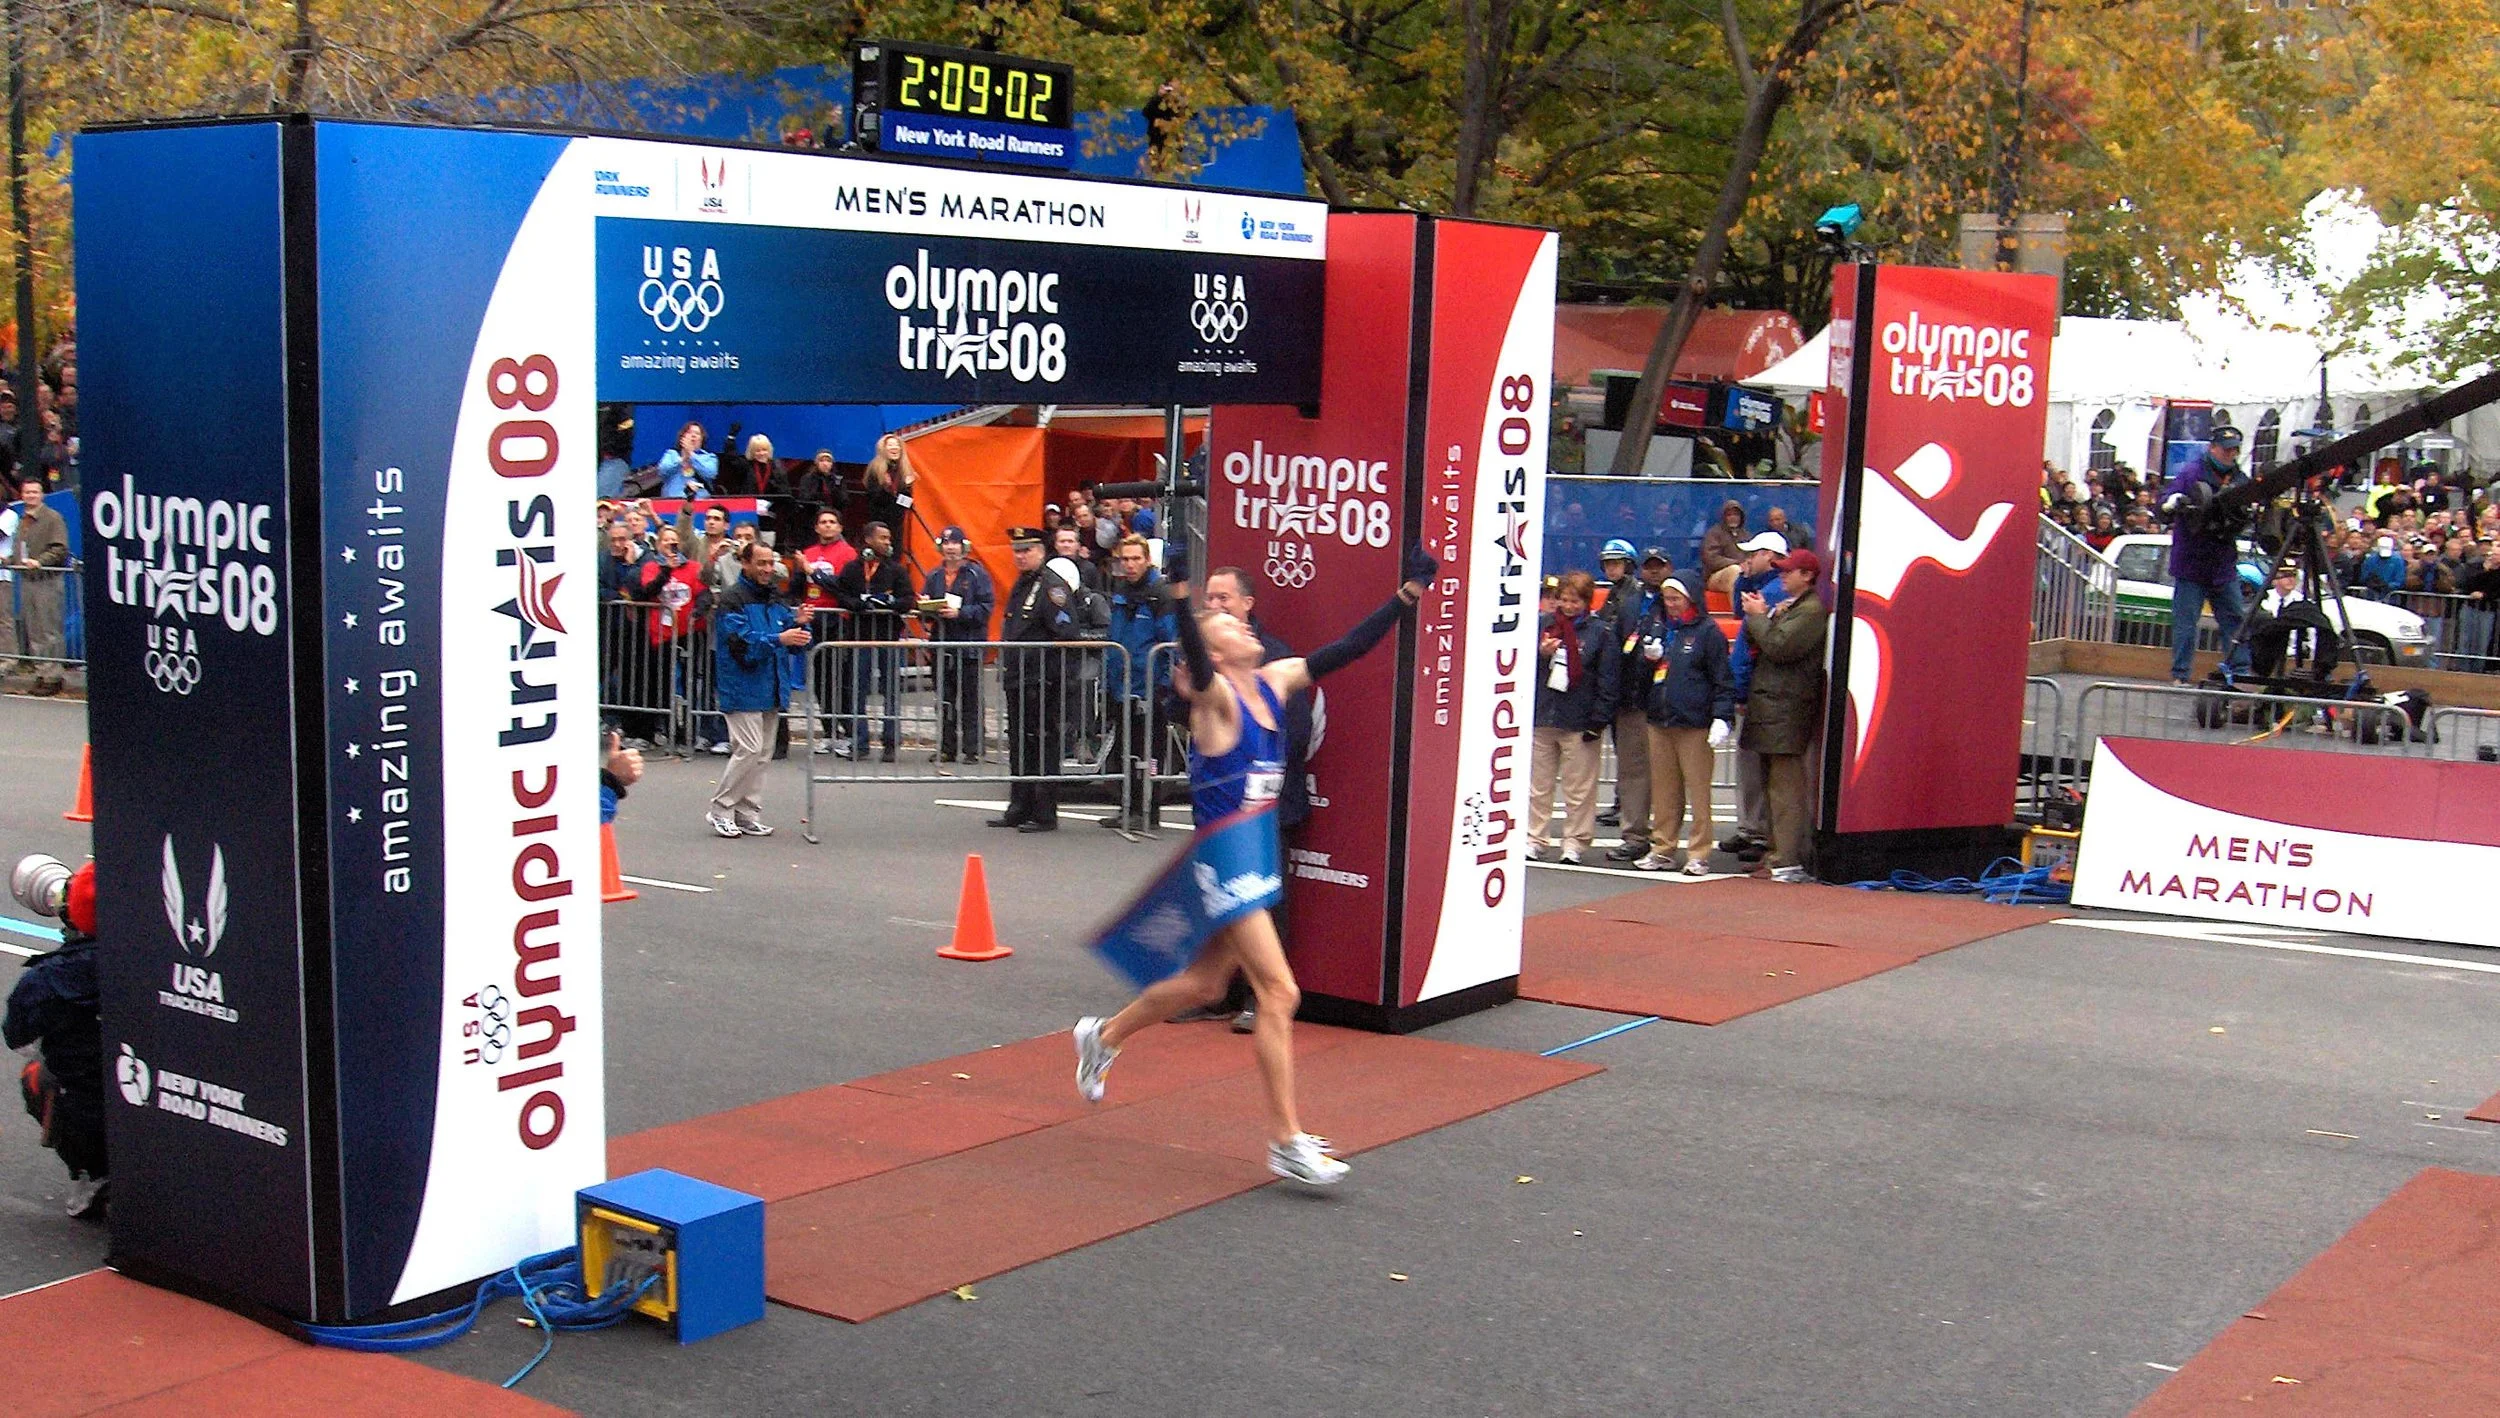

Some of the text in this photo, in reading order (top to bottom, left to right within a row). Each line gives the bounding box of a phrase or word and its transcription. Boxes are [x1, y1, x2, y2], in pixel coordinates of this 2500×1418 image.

[895, 125, 1064, 156] New York Road Runners
[835, 186, 1105, 227] MEN'S MARATHON
[643, 246, 721, 281] USA
[885, 248, 1059, 328] olympic
[1194, 273, 1246, 301] USA
[1882, 311, 2029, 367] olympic
[621, 352, 740, 374] amazing awaits
[1178, 359, 1222, 376] amazing
[1223, 440, 1389, 502] olympic
[93, 473, 271, 566] olympic
[1268, 541, 1314, 561] USA
[1434, 444, 1462, 726] amazing awaits
[147, 624, 199, 654] USA
[367, 466, 417, 893] amazing awaits
[1477, 648, 1521, 908] olympic
[2186, 834, 2314, 867] MEN'S
[1296, 864, 1370, 888] RUNNERS
[2119, 870, 2373, 917] MARATHON
[497, 764, 576, 1150] olympic
[172, 962, 225, 1004] USA
[463, 991, 481, 1065] USA
[158, 1069, 246, 1112] NEW YORK
[157, 1090, 288, 1147] ROAD RUNNERS
